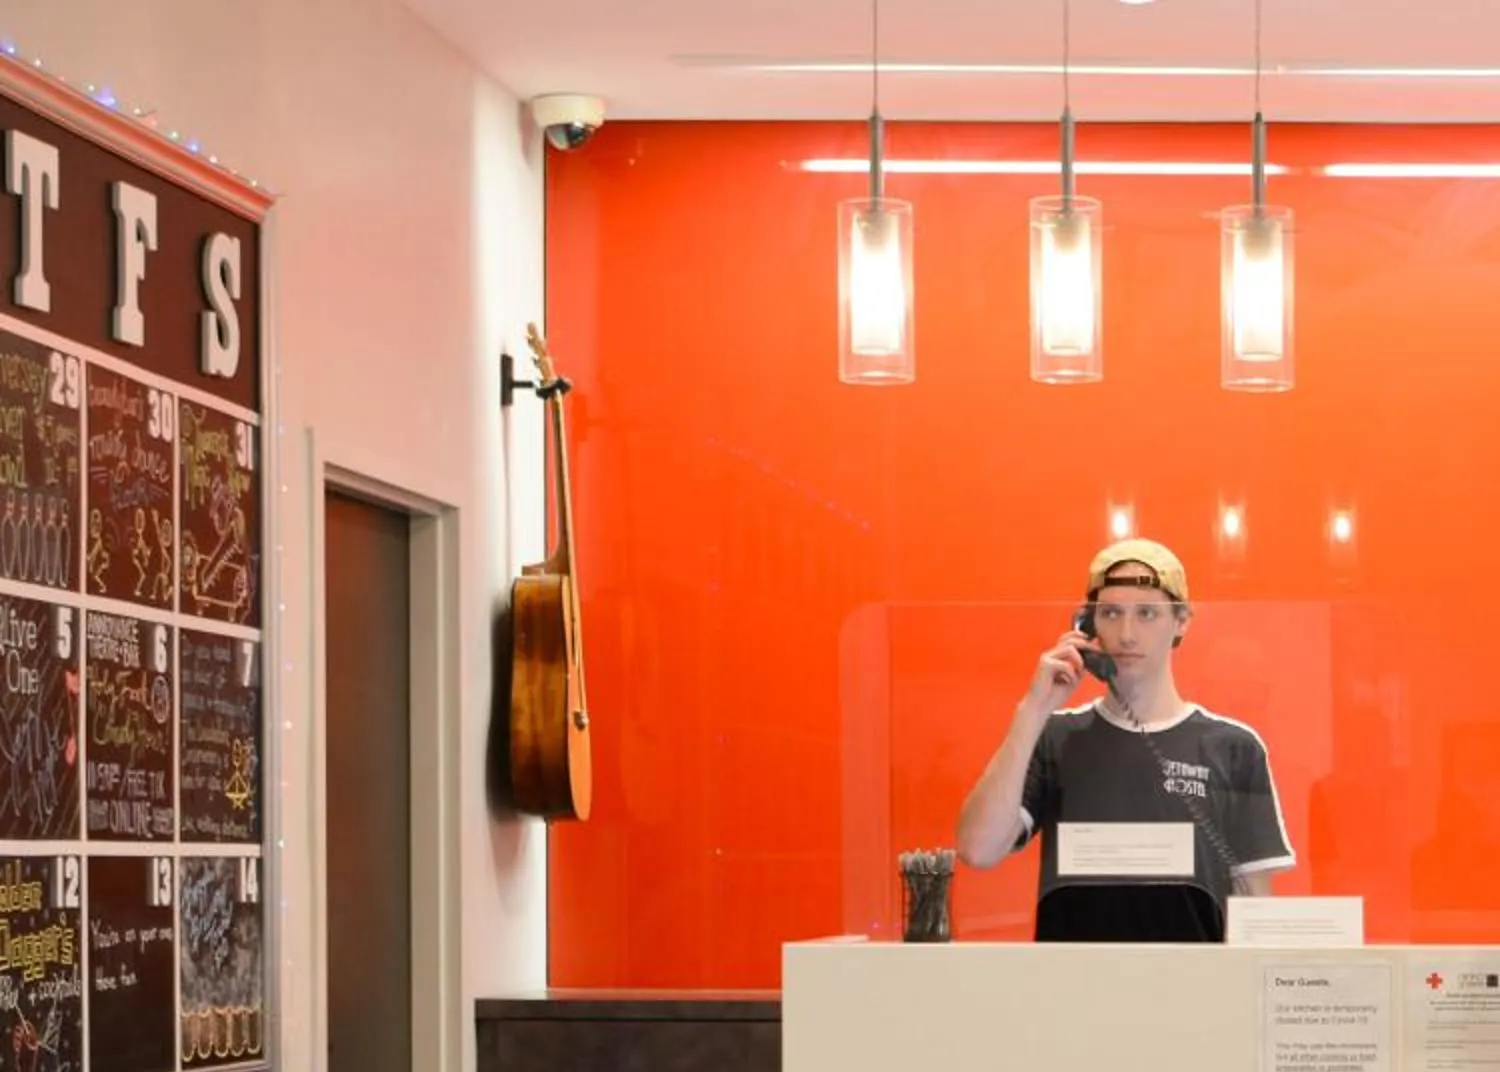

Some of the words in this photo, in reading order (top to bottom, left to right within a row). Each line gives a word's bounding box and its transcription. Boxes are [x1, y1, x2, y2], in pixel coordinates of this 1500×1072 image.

[5, 129, 59, 313] T
[112, 180, 158, 347] F
[202, 231, 242, 379] S
[50, 351, 80, 409] 29
[148, 388, 173, 442] 30
[235, 421, 253, 470] 31
[57, 606, 73, 660] 5
[153, 623, 168, 673] 6
[242, 642, 254, 688] 7
[56, 856, 80, 908] 12
[153, 858, 172, 907] 13
[240, 857, 258, 903] 14
